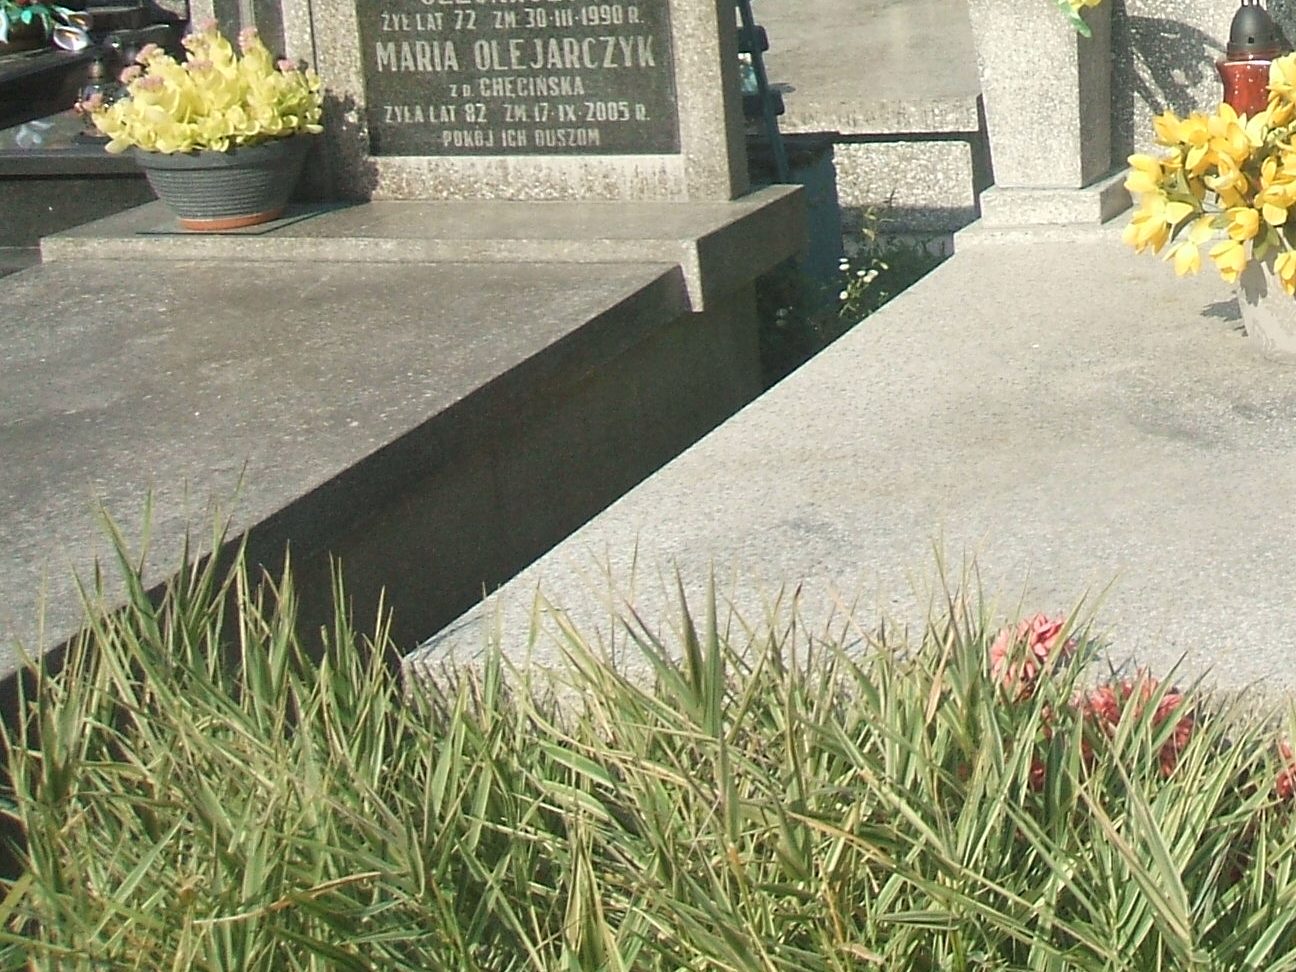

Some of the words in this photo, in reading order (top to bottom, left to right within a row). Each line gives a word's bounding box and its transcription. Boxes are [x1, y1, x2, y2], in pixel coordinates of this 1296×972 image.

[416, 12, 444, 31] LAT
[376, 40, 459, 72] MARIA
[474, 35, 656, 70] OLEJARCZYK
[479, 75, 585, 99] CHĘCIŃSKA
[429, 105, 456, 123] LAT
[465, 103, 488, 123] 82
[442, 125, 494, 147] POKÓJ
[502, 129, 527, 147] ICH
[535, 127, 600, 148] DUSZOM
